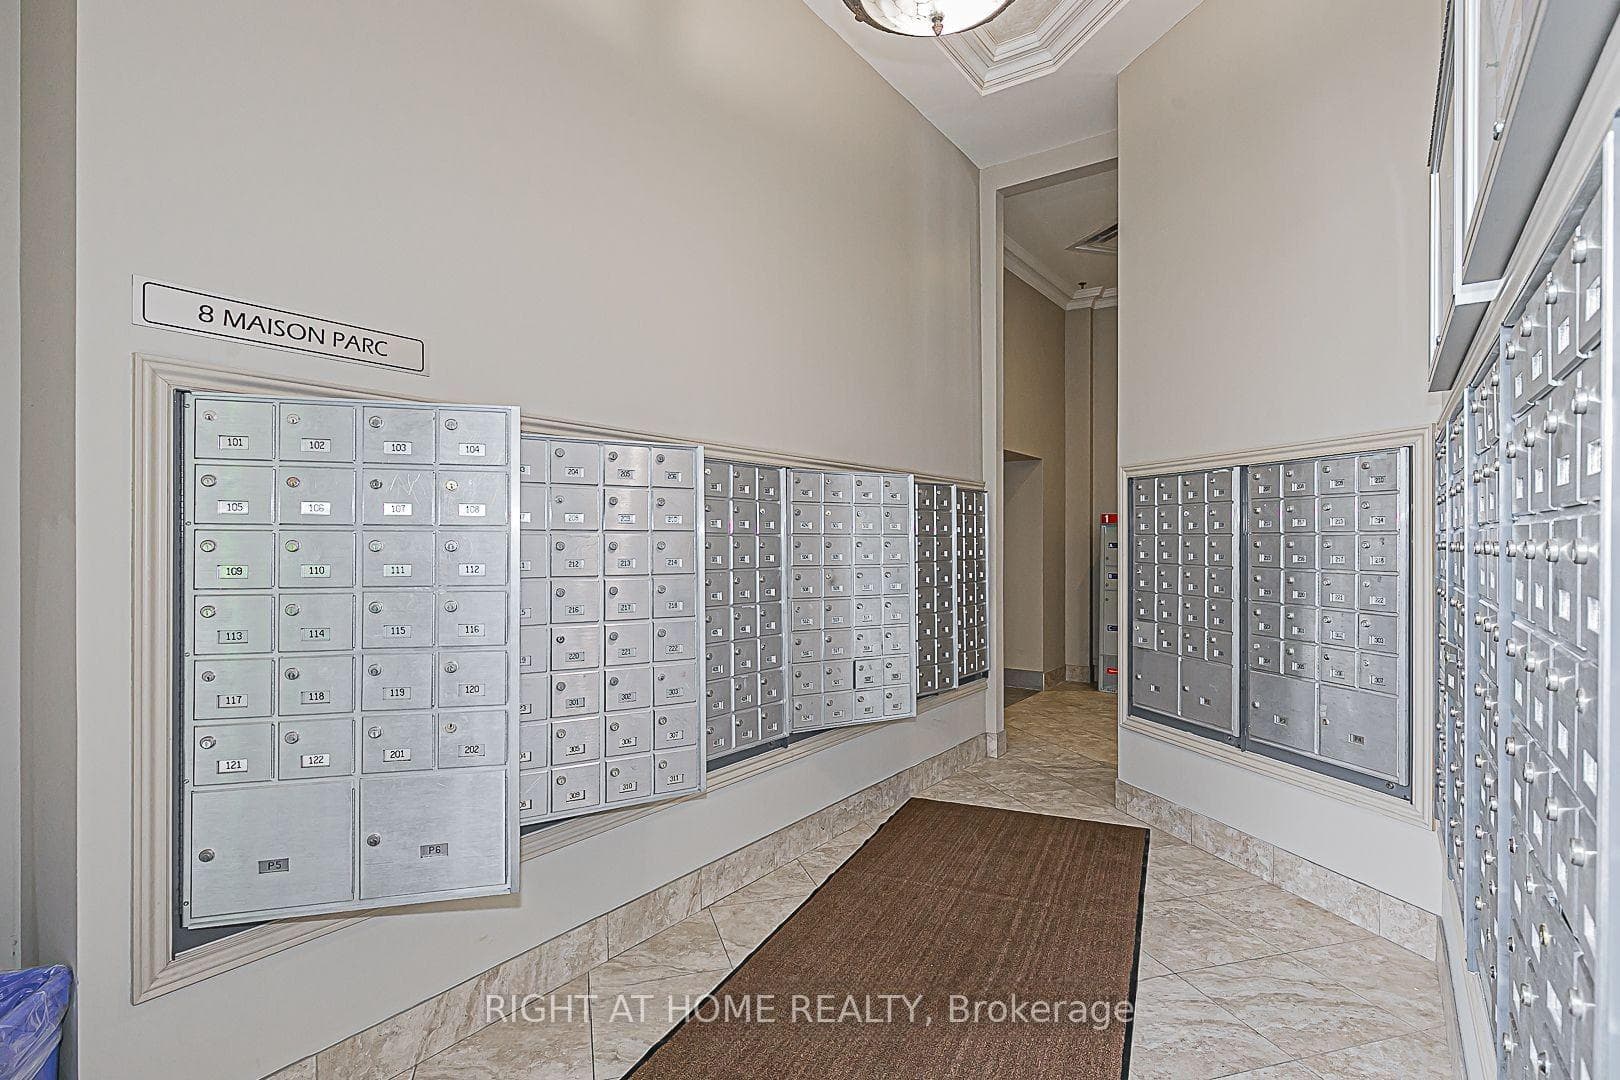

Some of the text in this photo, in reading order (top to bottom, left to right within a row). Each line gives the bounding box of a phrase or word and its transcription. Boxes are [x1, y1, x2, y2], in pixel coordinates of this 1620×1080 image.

[198, 304, 388, 357] 8 MAISON PARC
[227, 437, 244, 447] 101
[309, 440, 325, 450] 102
[391, 443, 407, 452] 103
[465, 444, 480, 454] 104
[567, 468, 579, 476] 204
[226, 502, 243, 512] 105
[308, 503, 325, 513] 106
[391, 504, 406, 513] 107
[465, 505, 480, 514] 108
[568, 560, 579, 568] 212
[620, 559, 631, 567] 213
[226, 566, 243, 576] 109
[308, 566, 325, 575] 110
[391, 566, 405, 575] 111
[465, 565, 480, 574] 112
[568, 606, 579, 614] 216
[620, 604, 631, 612] 217
[308, 629, 325, 639] 114
[391, 626, 406, 635] 115
[464, 625, 480, 634] 116
[226, 631, 243, 641] 113
[621, 648, 631, 656] 221
[390, 688, 405, 698] 119
[464, 685, 480, 694] 120
[668, 688, 679, 696] 303
[225, 695, 243, 705] 117
[308, 692, 325, 702] 118
[621, 693, 632, 701] 302
[669, 731, 679, 739] 307
[389, 750, 405, 759] 201
[464, 745, 480, 755] 202
[308, 755, 324, 765] 122
[225, 760, 242, 770] 121
[669, 775, 679, 783] 311
[622, 783, 633, 791] 310
[569, 791, 581, 800] 309
[428, 845, 441, 855] P6
[267, 860, 282, 871] P5
